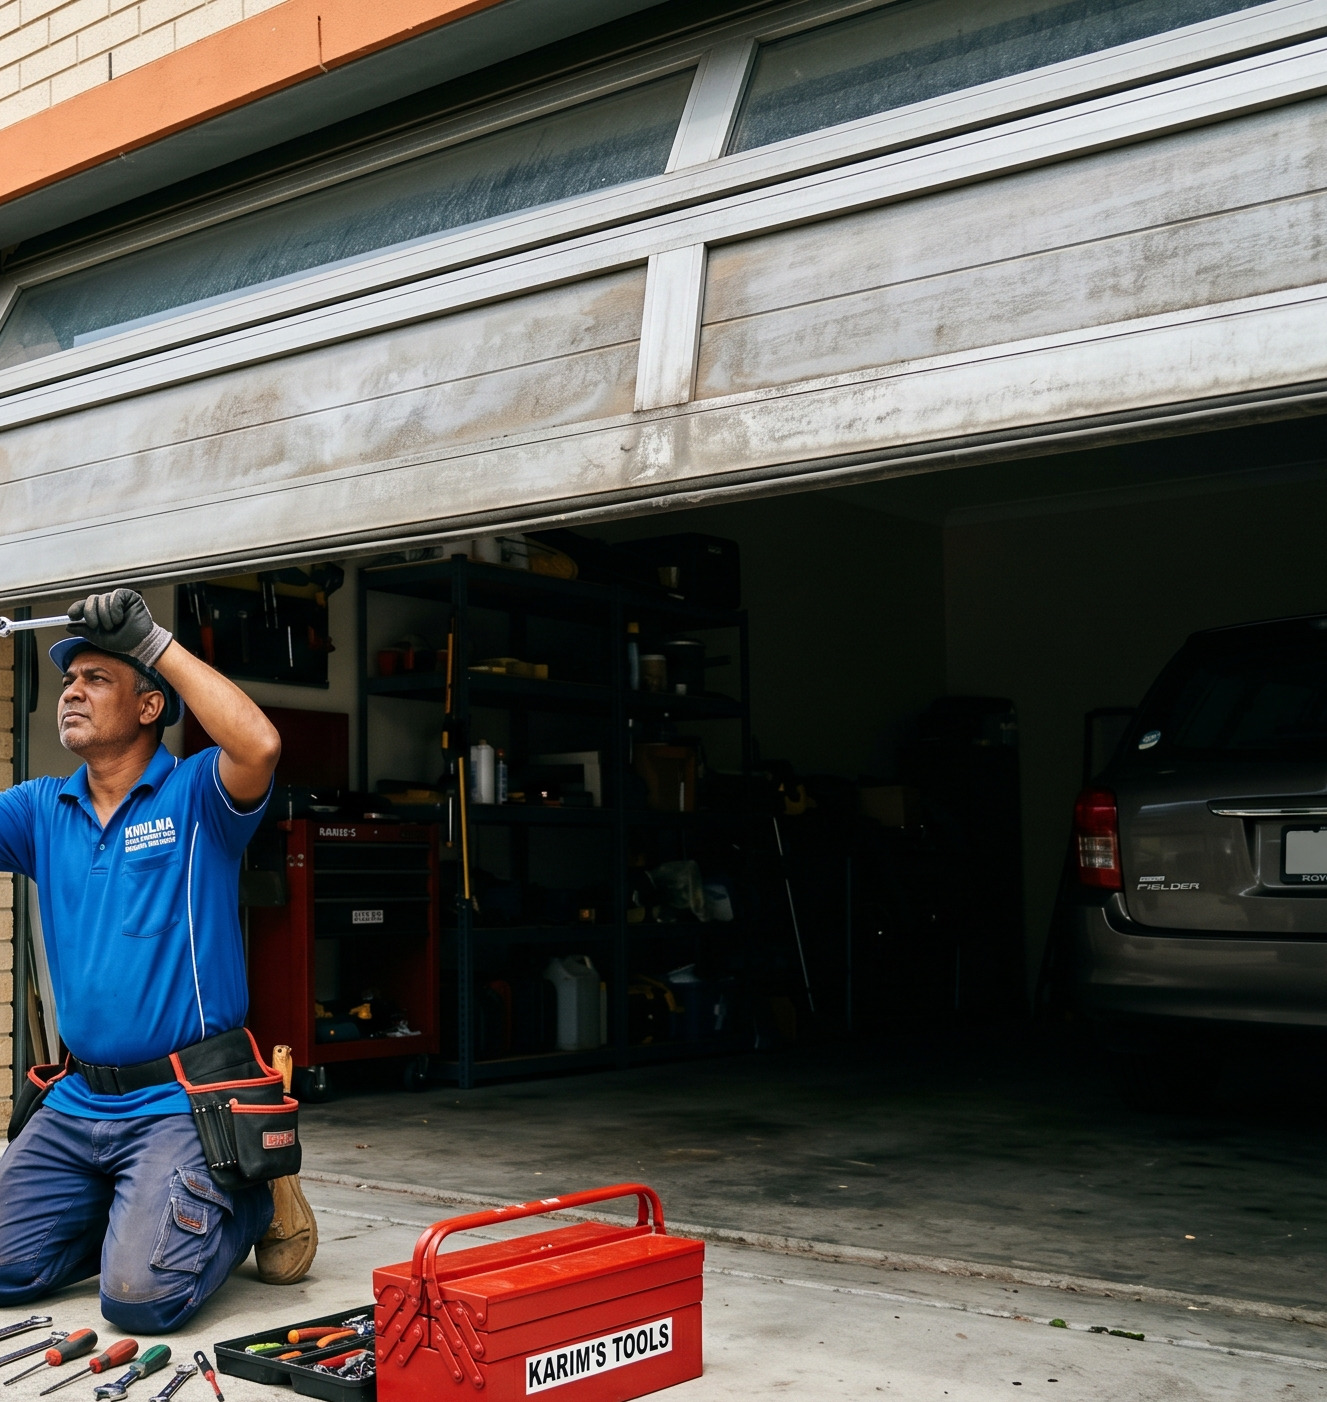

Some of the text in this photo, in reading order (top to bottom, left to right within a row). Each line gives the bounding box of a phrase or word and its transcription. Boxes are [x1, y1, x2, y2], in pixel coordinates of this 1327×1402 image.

[1302, 874, 1327, 882] ROY
[529, 1323, 669, 1388] KARIM'S TOOLS
